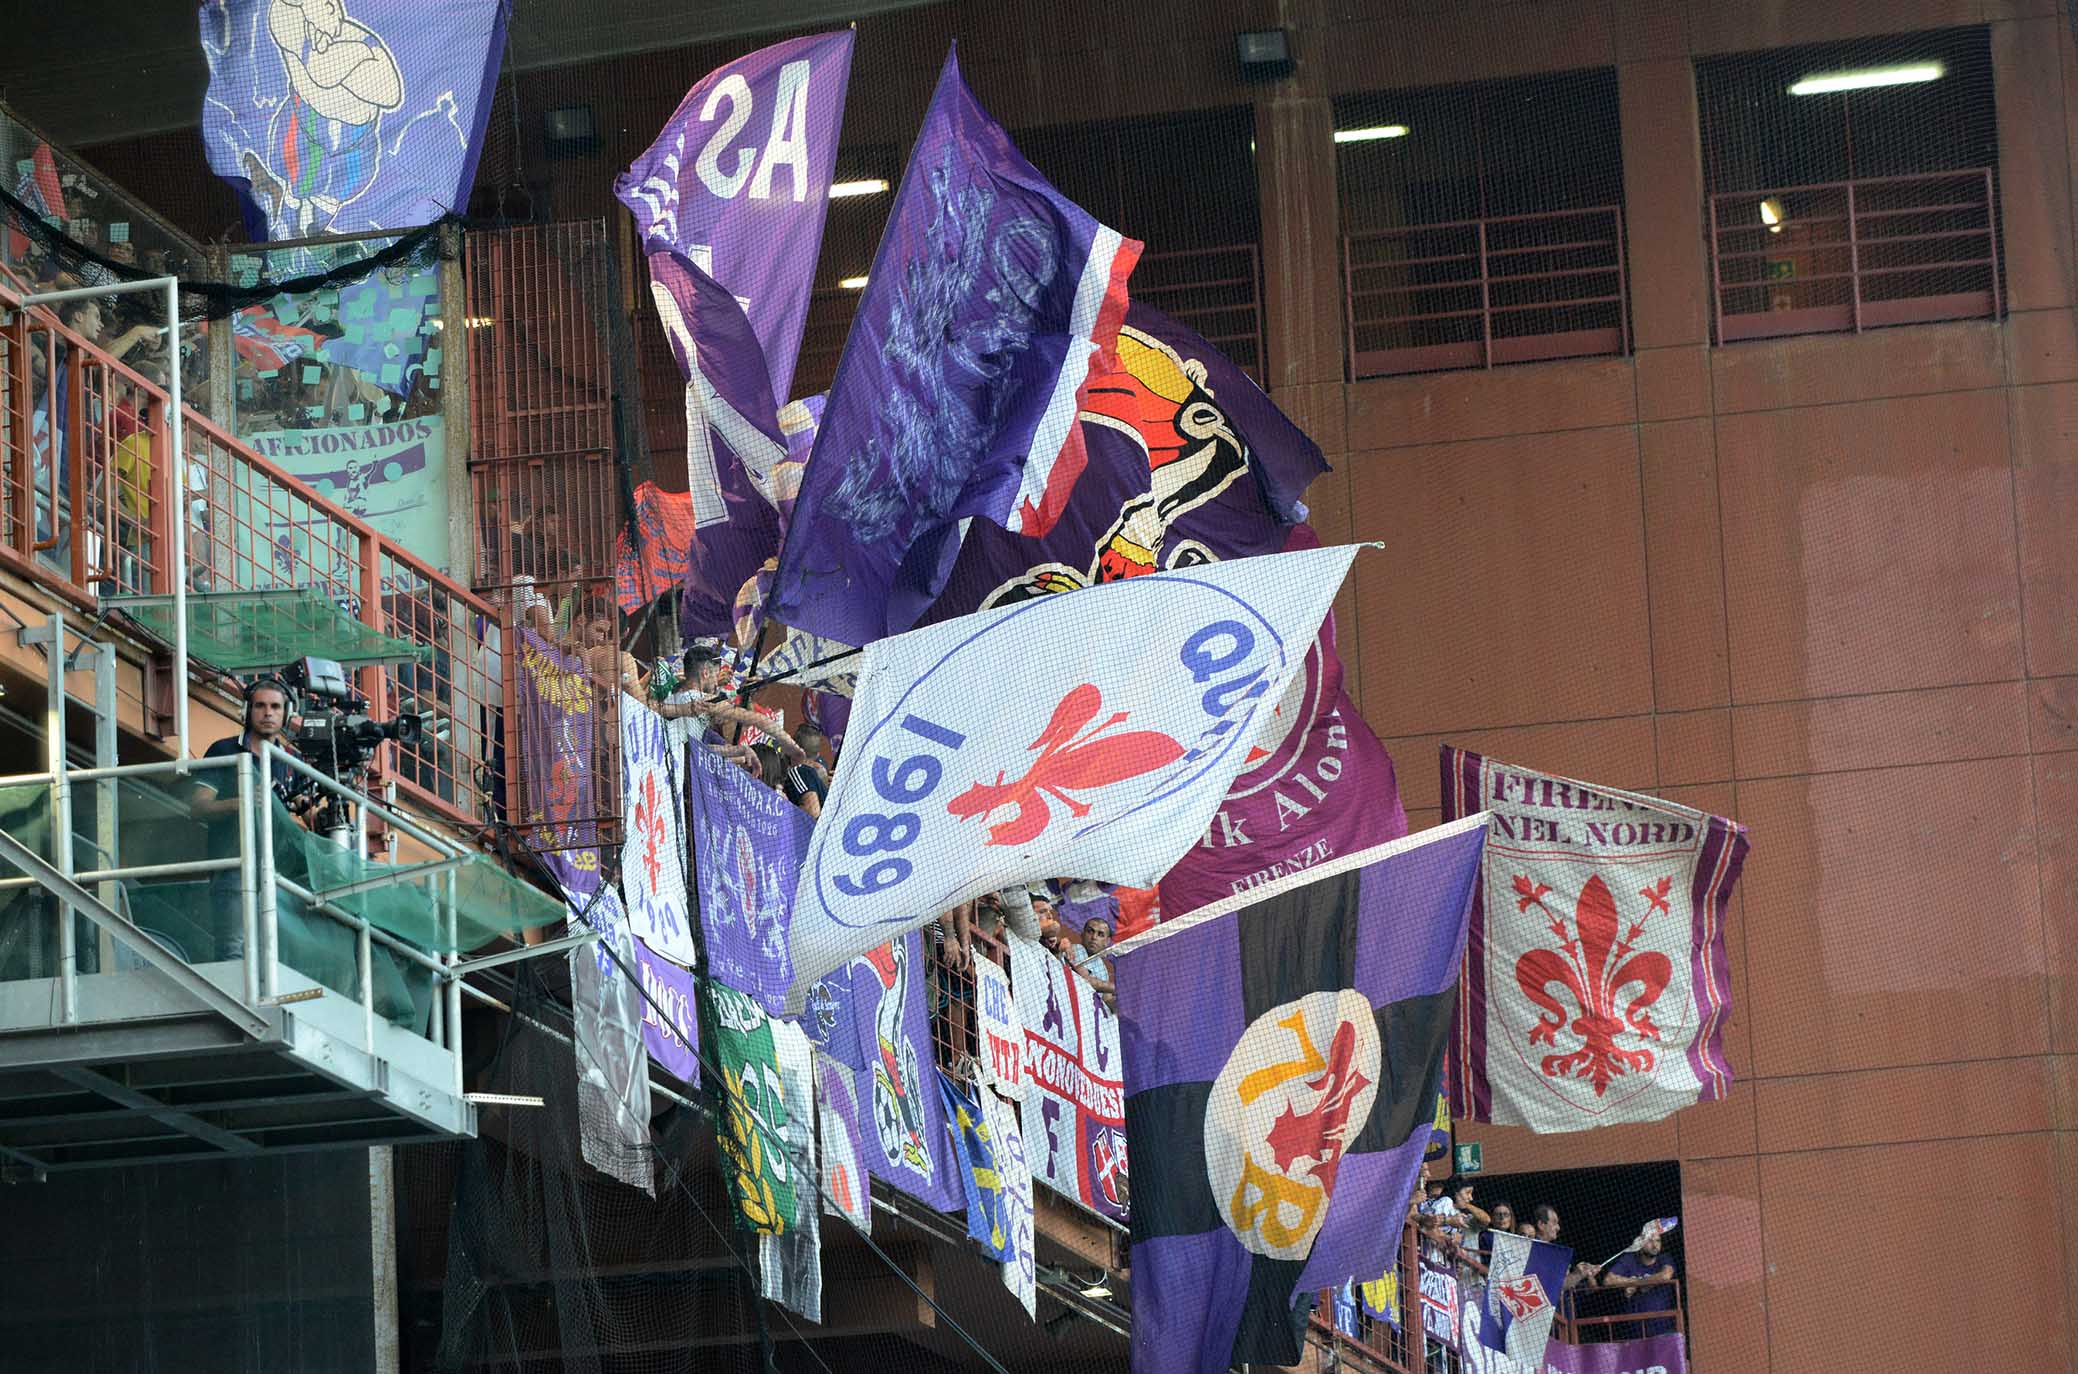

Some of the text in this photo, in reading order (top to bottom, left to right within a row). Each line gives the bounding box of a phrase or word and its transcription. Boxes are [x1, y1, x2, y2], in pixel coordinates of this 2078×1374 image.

[1273, 707, 1350, 832] Alon
[1492, 771, 1650, 811] FIRE
[832, 714, 966, 898] 1989
[1493, 814, 1697, 848] NEL NORD
[1230, 838, 1335, 896] FIRENZE
